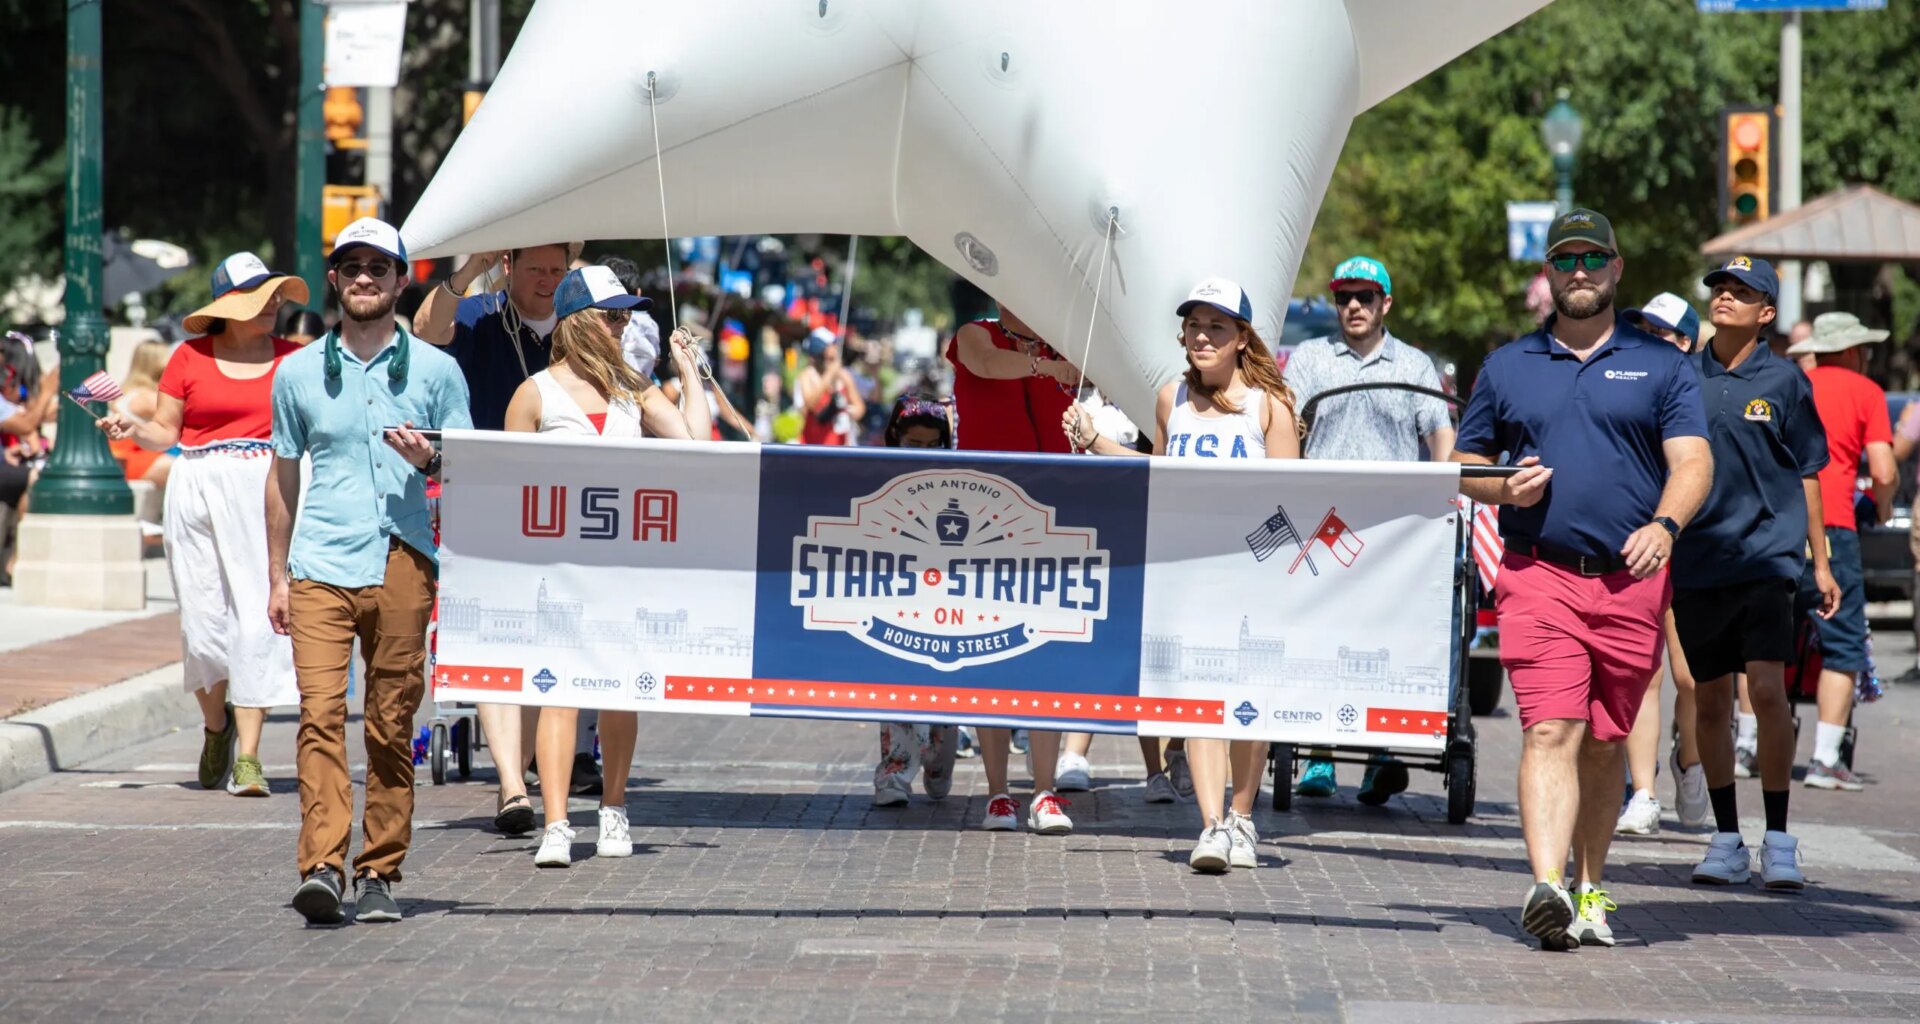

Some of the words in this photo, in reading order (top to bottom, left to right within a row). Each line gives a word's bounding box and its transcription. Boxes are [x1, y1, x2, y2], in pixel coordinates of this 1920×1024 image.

[907, 480, 935, 496] SAN
[940, 479, 1002, 499] ANTONIO
[522, 485, 678, 542] USA
[798, 543, 918, 599] STARS
[947, 556, 1103, 612] STRIPES
[934, 607, 964, 626] ON
[883, 626, 950, 653] HOUSTON
[956, 632, 1011, 654] STREET
[572, 677, 622, 689] CENTRO
[1273, 710, 1323, 721] CENTRO
